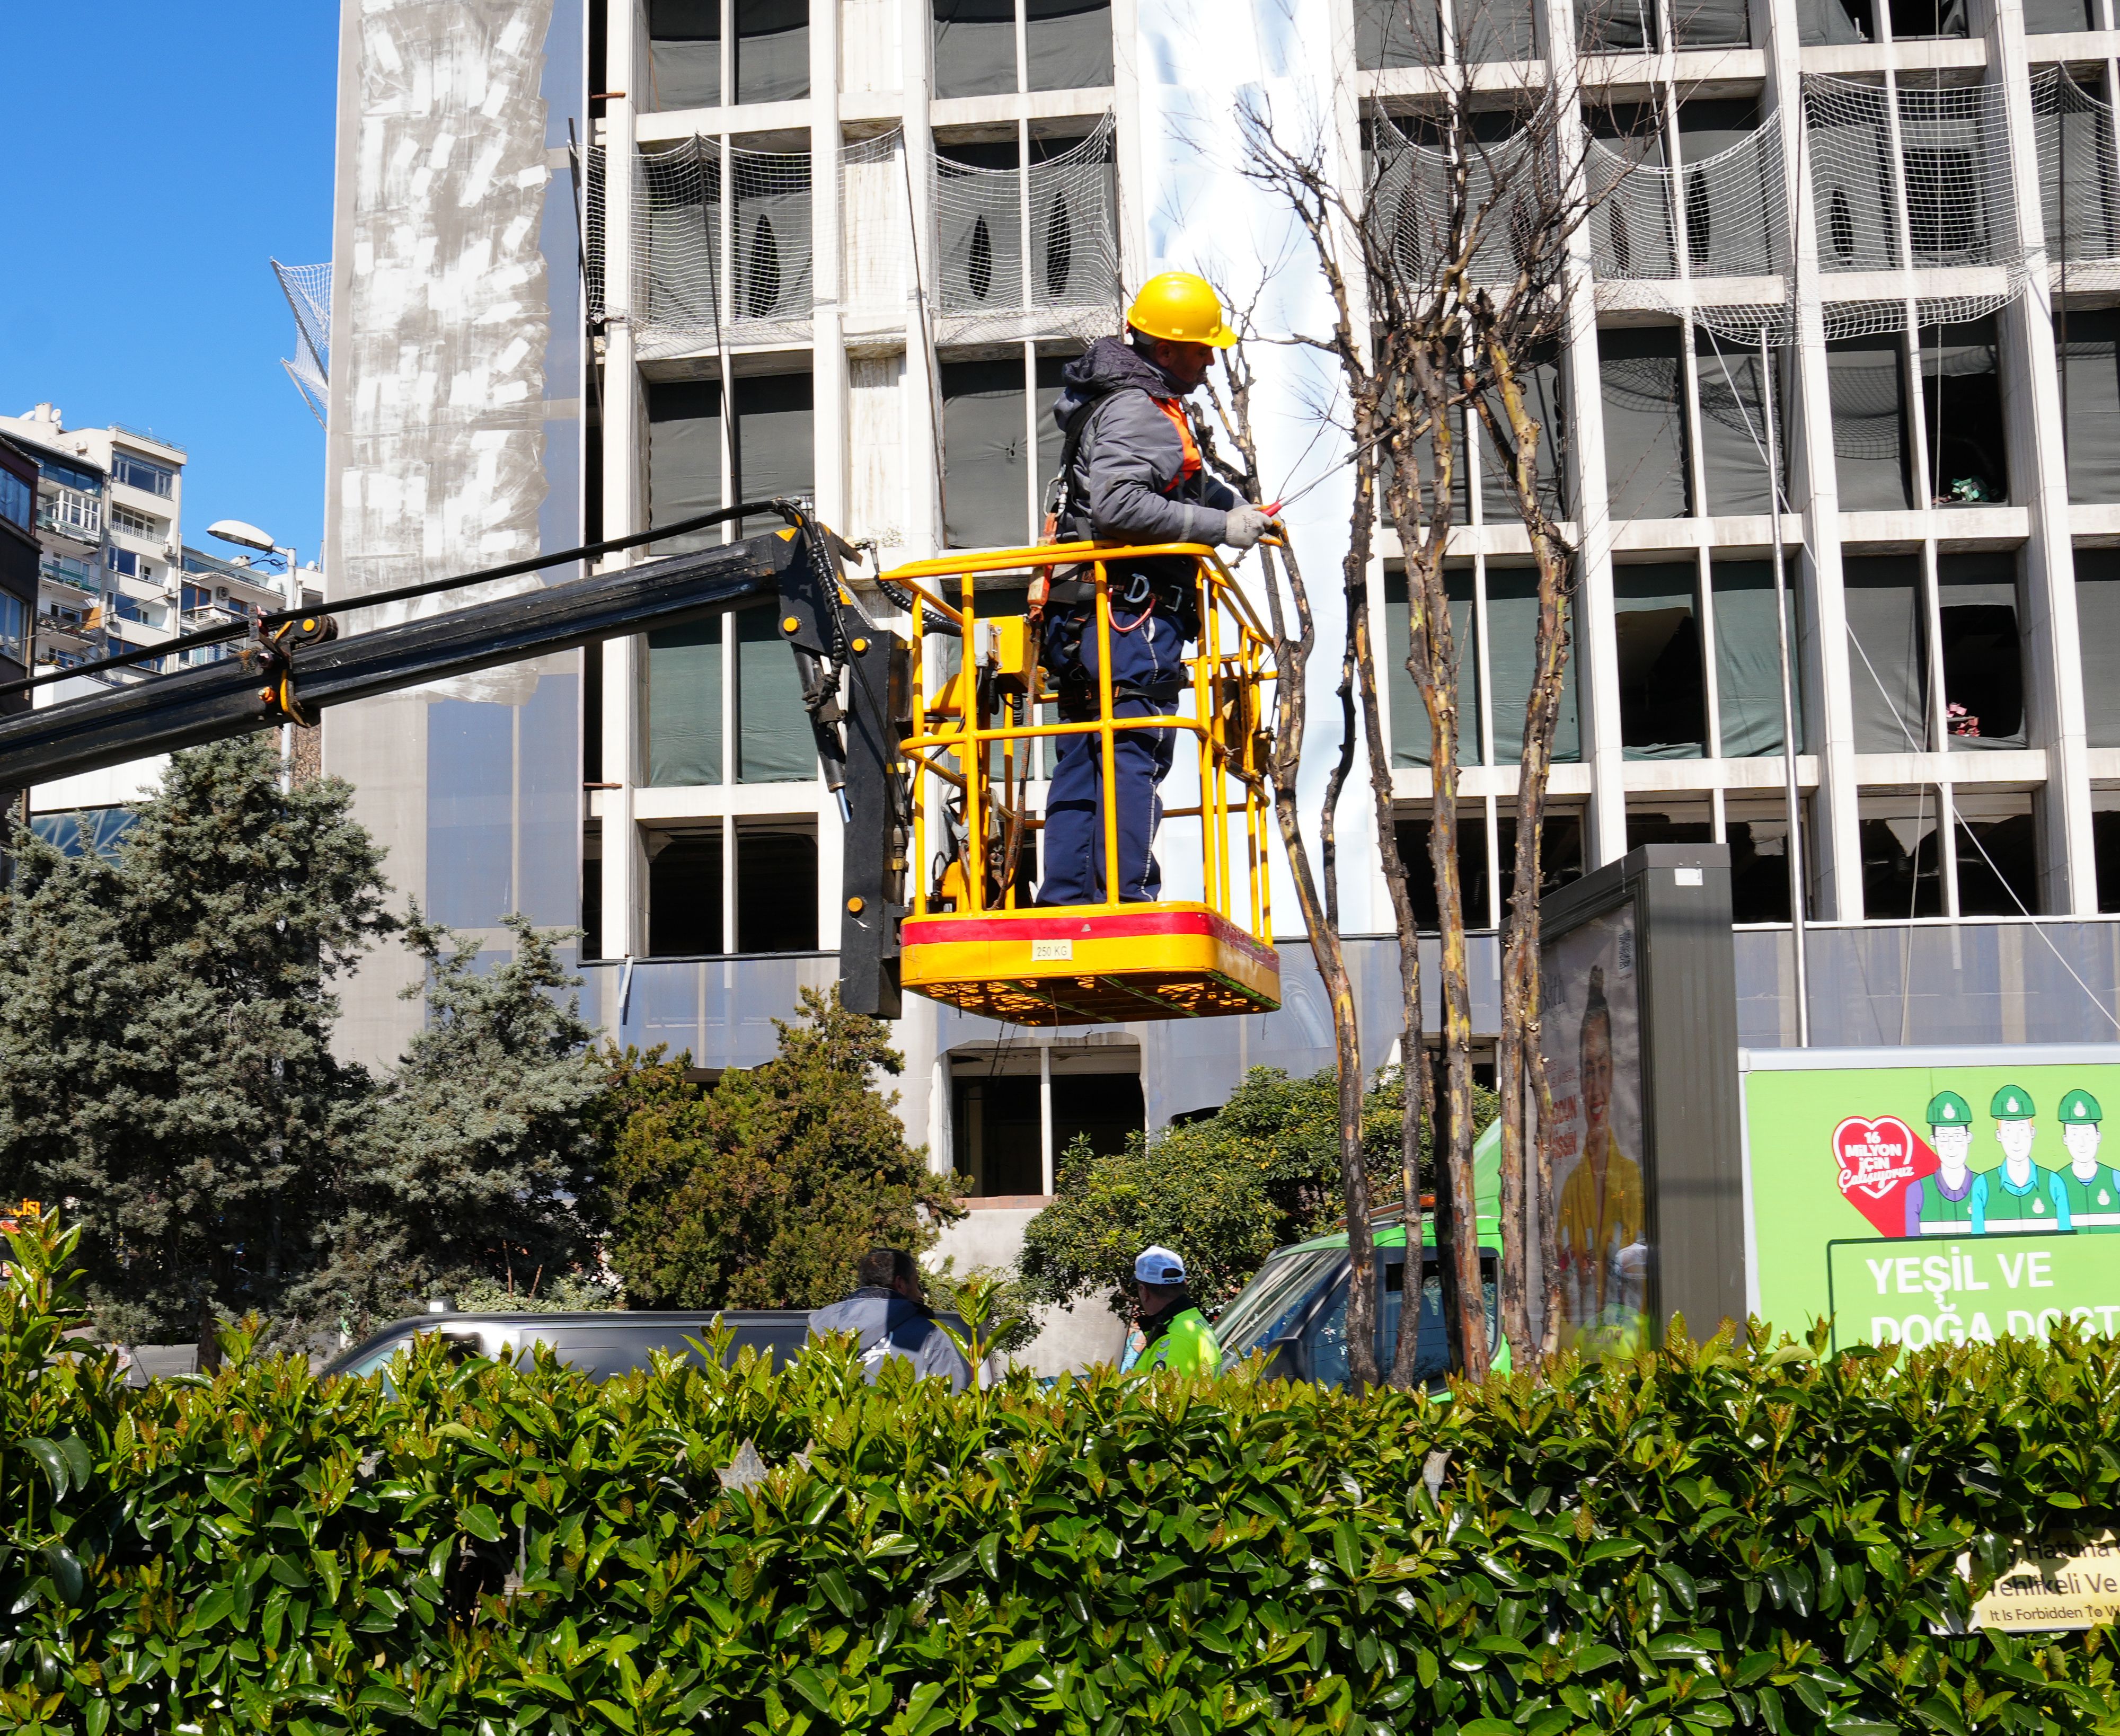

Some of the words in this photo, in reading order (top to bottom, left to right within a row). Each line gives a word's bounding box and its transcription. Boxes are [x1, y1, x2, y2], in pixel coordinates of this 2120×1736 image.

[1037, 946, 1052, 956] 250
[1054, 945, 1067, 956] KG
[1863, 1131, 1881, 1144] 16
[1844, 1144, 1902, 1157] MİLYON
[1866, 1246, 1989, 1304] YEŞİL
[1997, 1252, 2053, 1288] VE
[1871, 1303, 1996, 1352] DOĞA
[2084, 1573, 2118, 1593] Ve
[1990, 1610, 2000, 1622] It
[2002, 1609, 2012, 1620] Is
[2015, 1606, 2083, 1620] Forbidden
[2083, 1605, 2103, 1617] To
